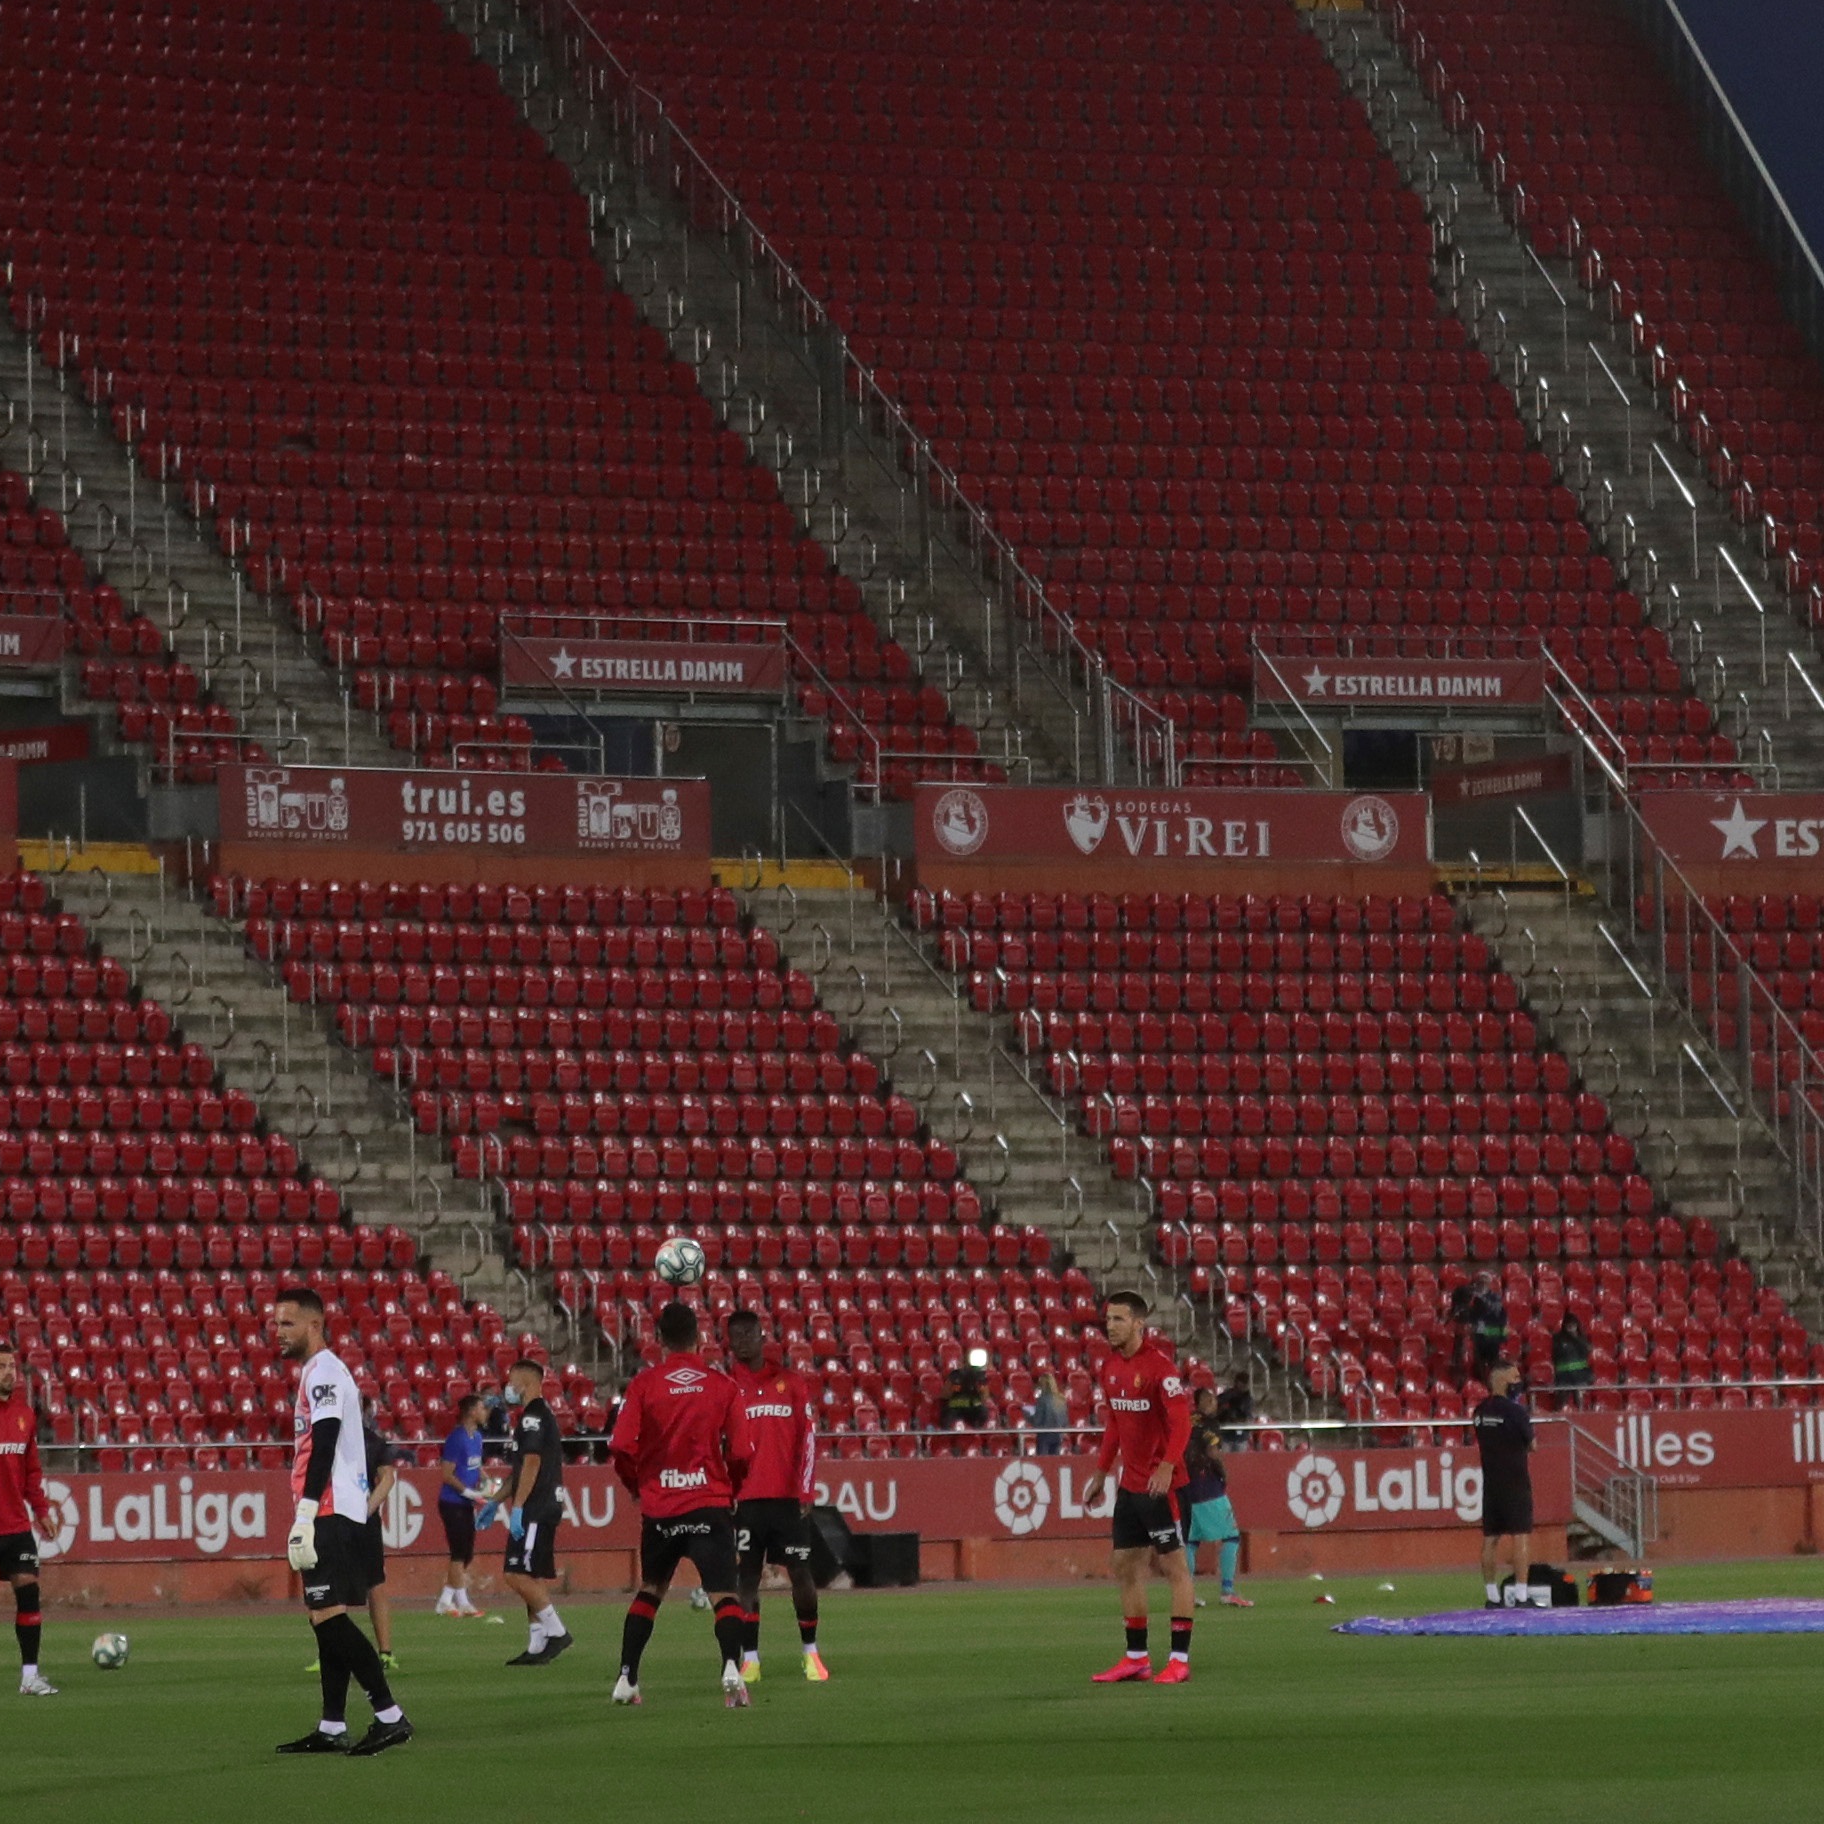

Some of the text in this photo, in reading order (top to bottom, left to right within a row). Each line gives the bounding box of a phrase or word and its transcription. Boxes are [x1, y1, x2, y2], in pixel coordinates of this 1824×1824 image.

[581, 657, 744, 683] ESTRELLA DAMM
[1335, 676, 1502, 697] ESTRELLA DAMM
[402, 779, 526, 818] trui.es
[1115, 801, 1193, 814] BODEGAS
[402, 820, 526, 845] 971 605 506
[669, 1384, 704, 1395] umbro
[1110, 1397, 1151, 1412] ETFRED
[1615, 1414, 1715, 1469] illes
[660, 1467, 707, 1489] fibwi
[1354, 1451, 1484, 1523] LaLig
[88, 1475, 267, 1554] LaLiga
